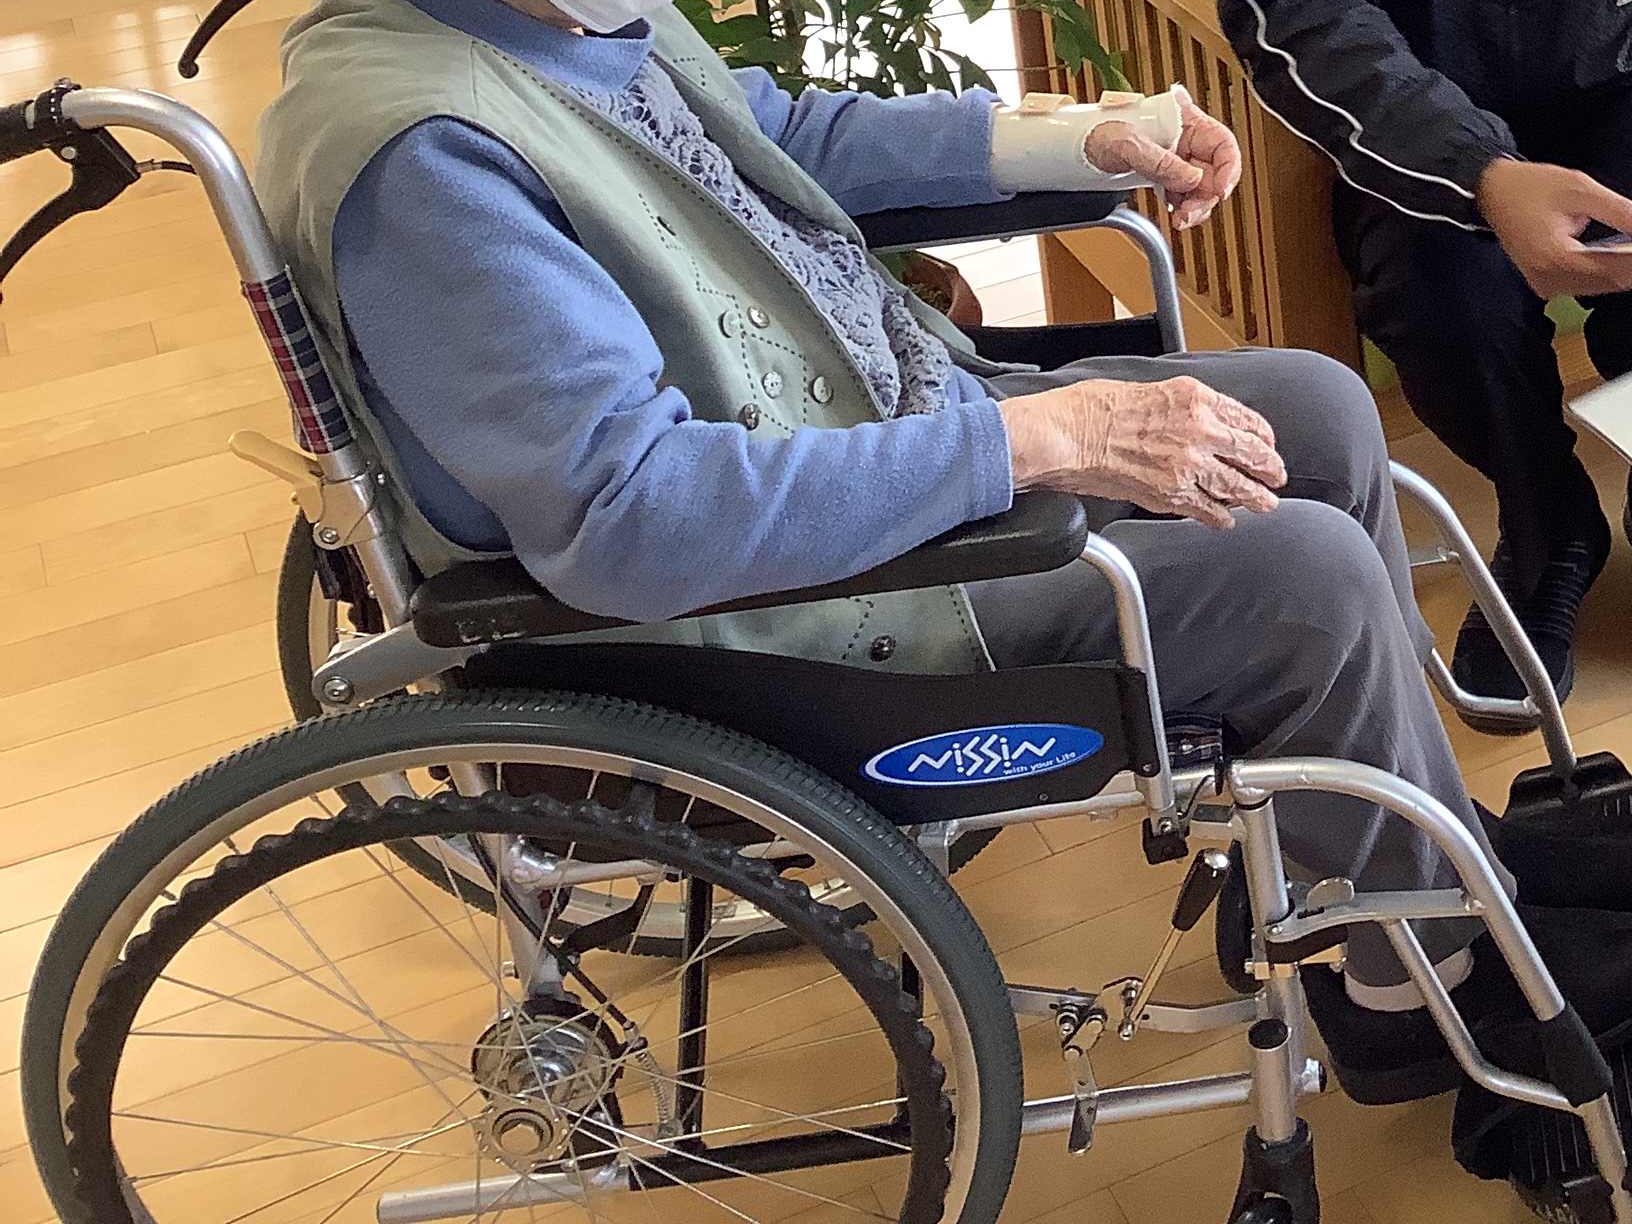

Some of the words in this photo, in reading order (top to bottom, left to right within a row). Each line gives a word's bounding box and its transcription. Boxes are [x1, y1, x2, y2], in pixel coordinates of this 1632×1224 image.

[1003, 764, 1028, 776] with
[1031, 758, 1054, 772] your
[1056, 751, 1077, 765] Life
